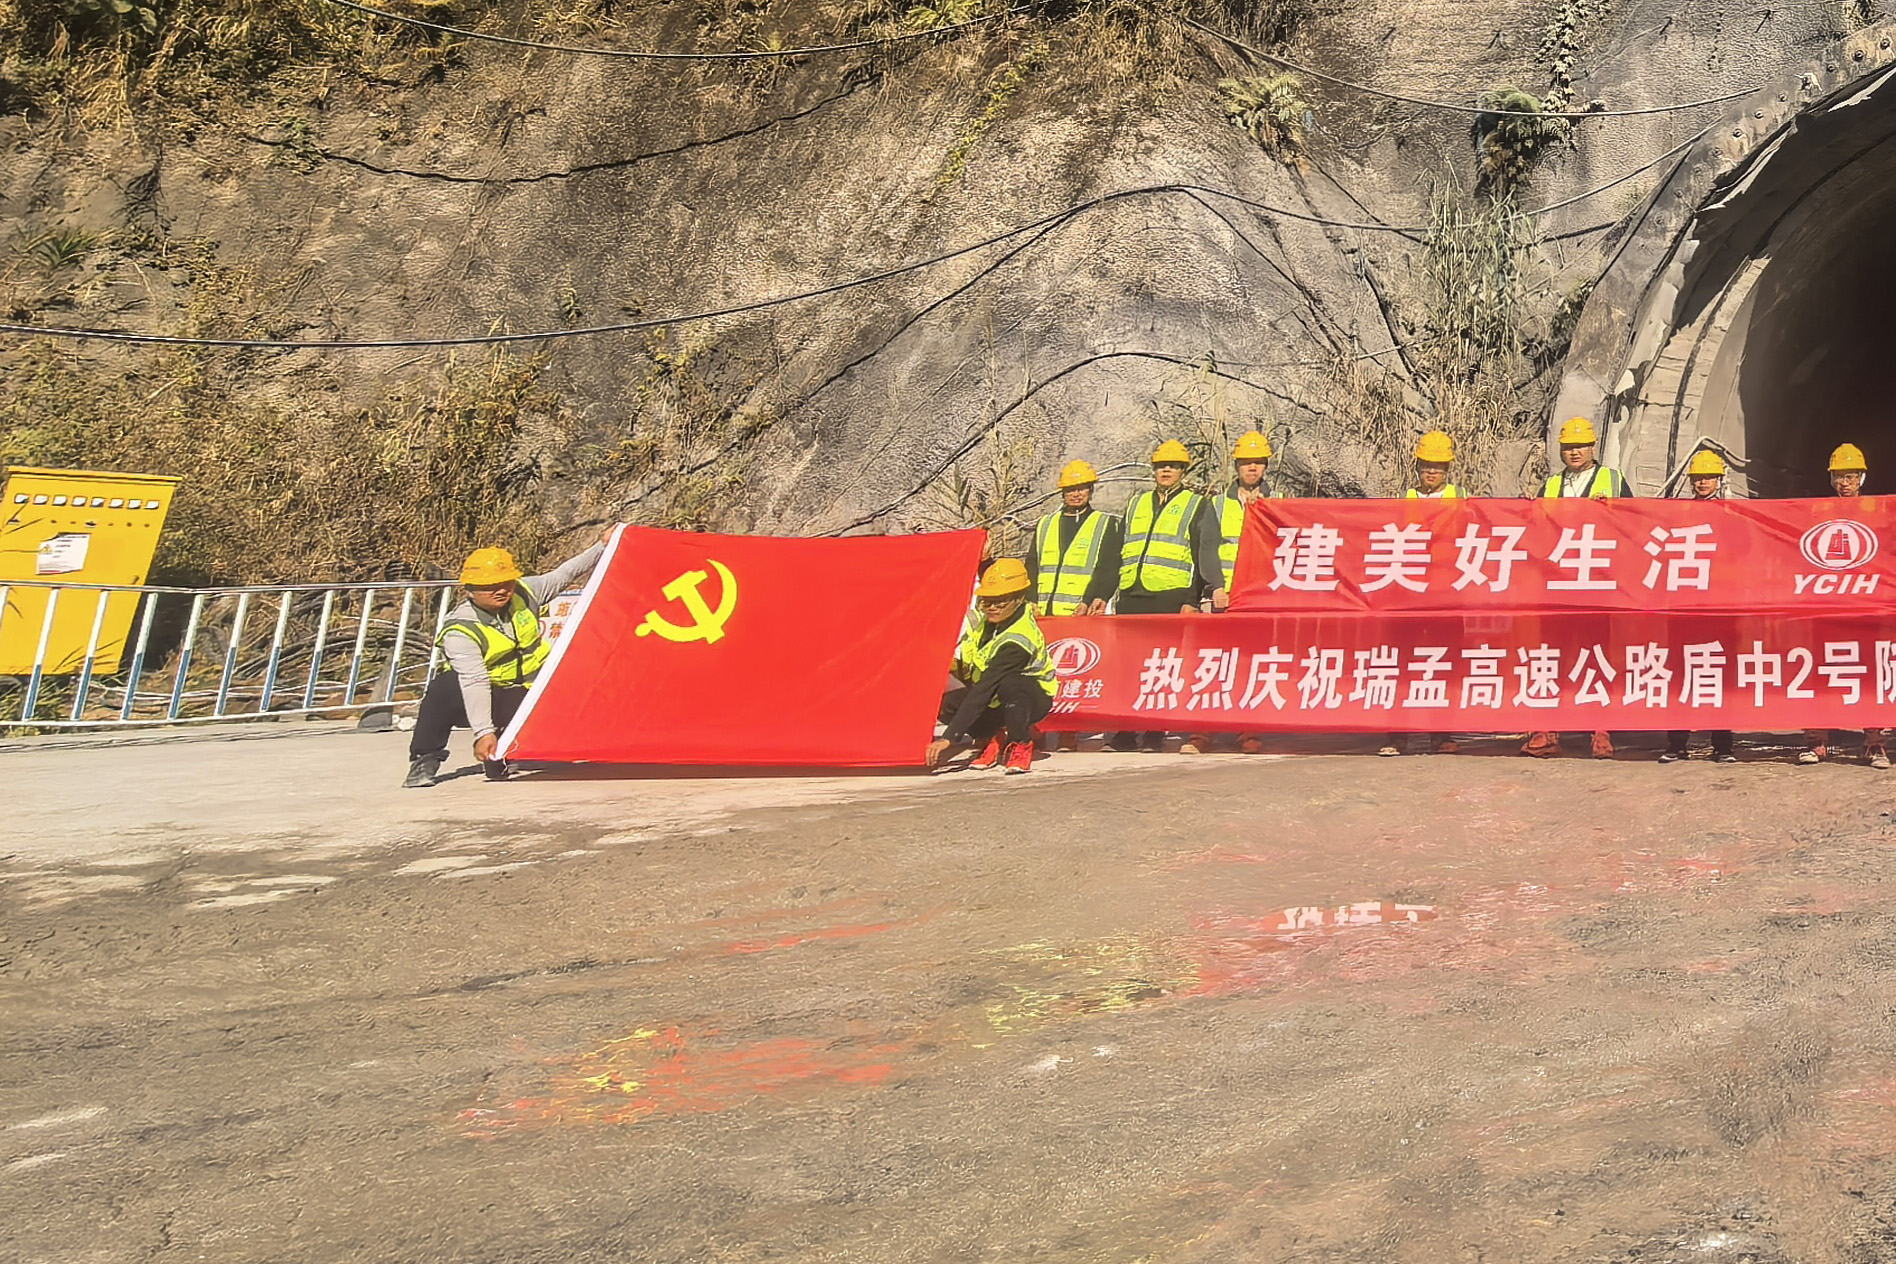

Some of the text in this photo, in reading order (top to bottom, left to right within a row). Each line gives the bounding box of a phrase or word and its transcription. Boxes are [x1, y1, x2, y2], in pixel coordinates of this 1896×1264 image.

[1269, 522, 1718, 593] 建美好生活
[1793, 574, 1880, 595] YCIH
[1055, 678, 1104, 698] 建投
